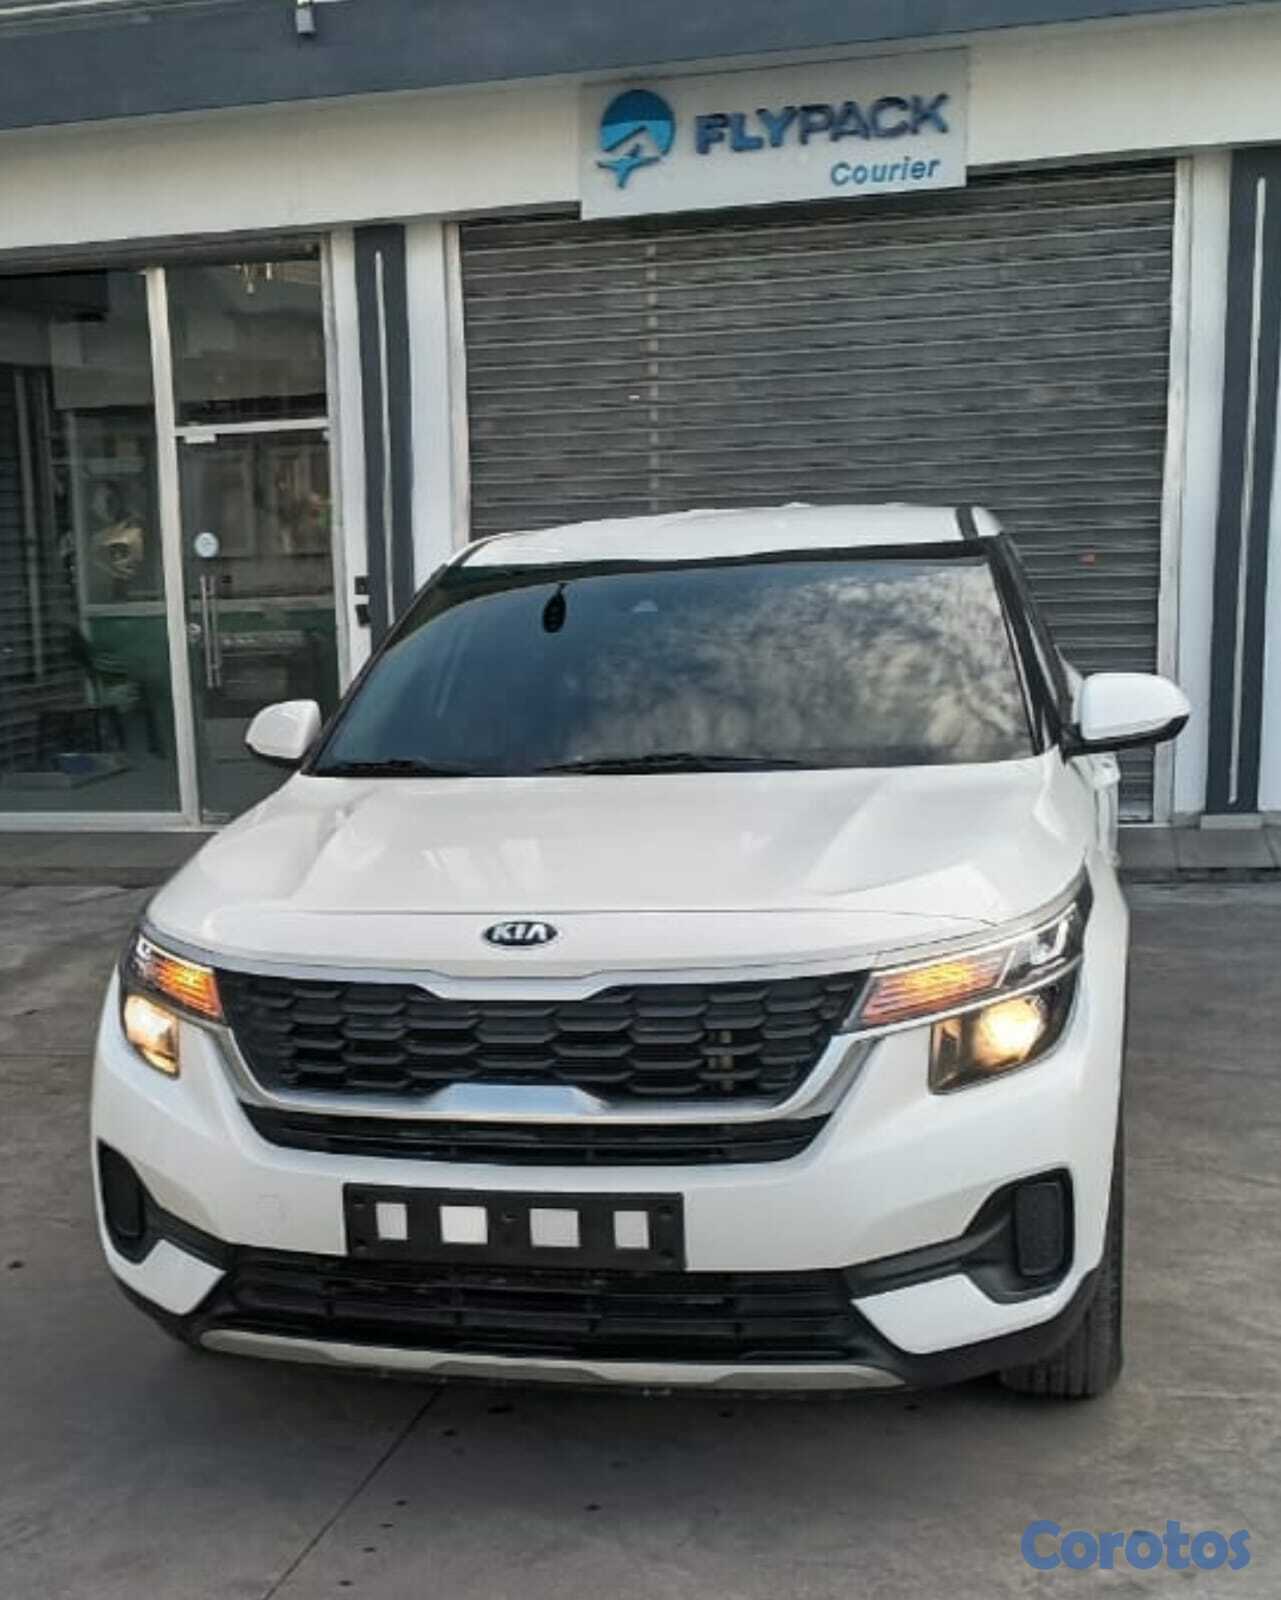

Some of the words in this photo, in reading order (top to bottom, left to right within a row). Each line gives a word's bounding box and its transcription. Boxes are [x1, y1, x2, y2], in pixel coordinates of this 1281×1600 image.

[695, 92, 951, 155] FLYPACK
[831, 156, 941, 187] Courier
[491, 923, 547, 940] KIA
